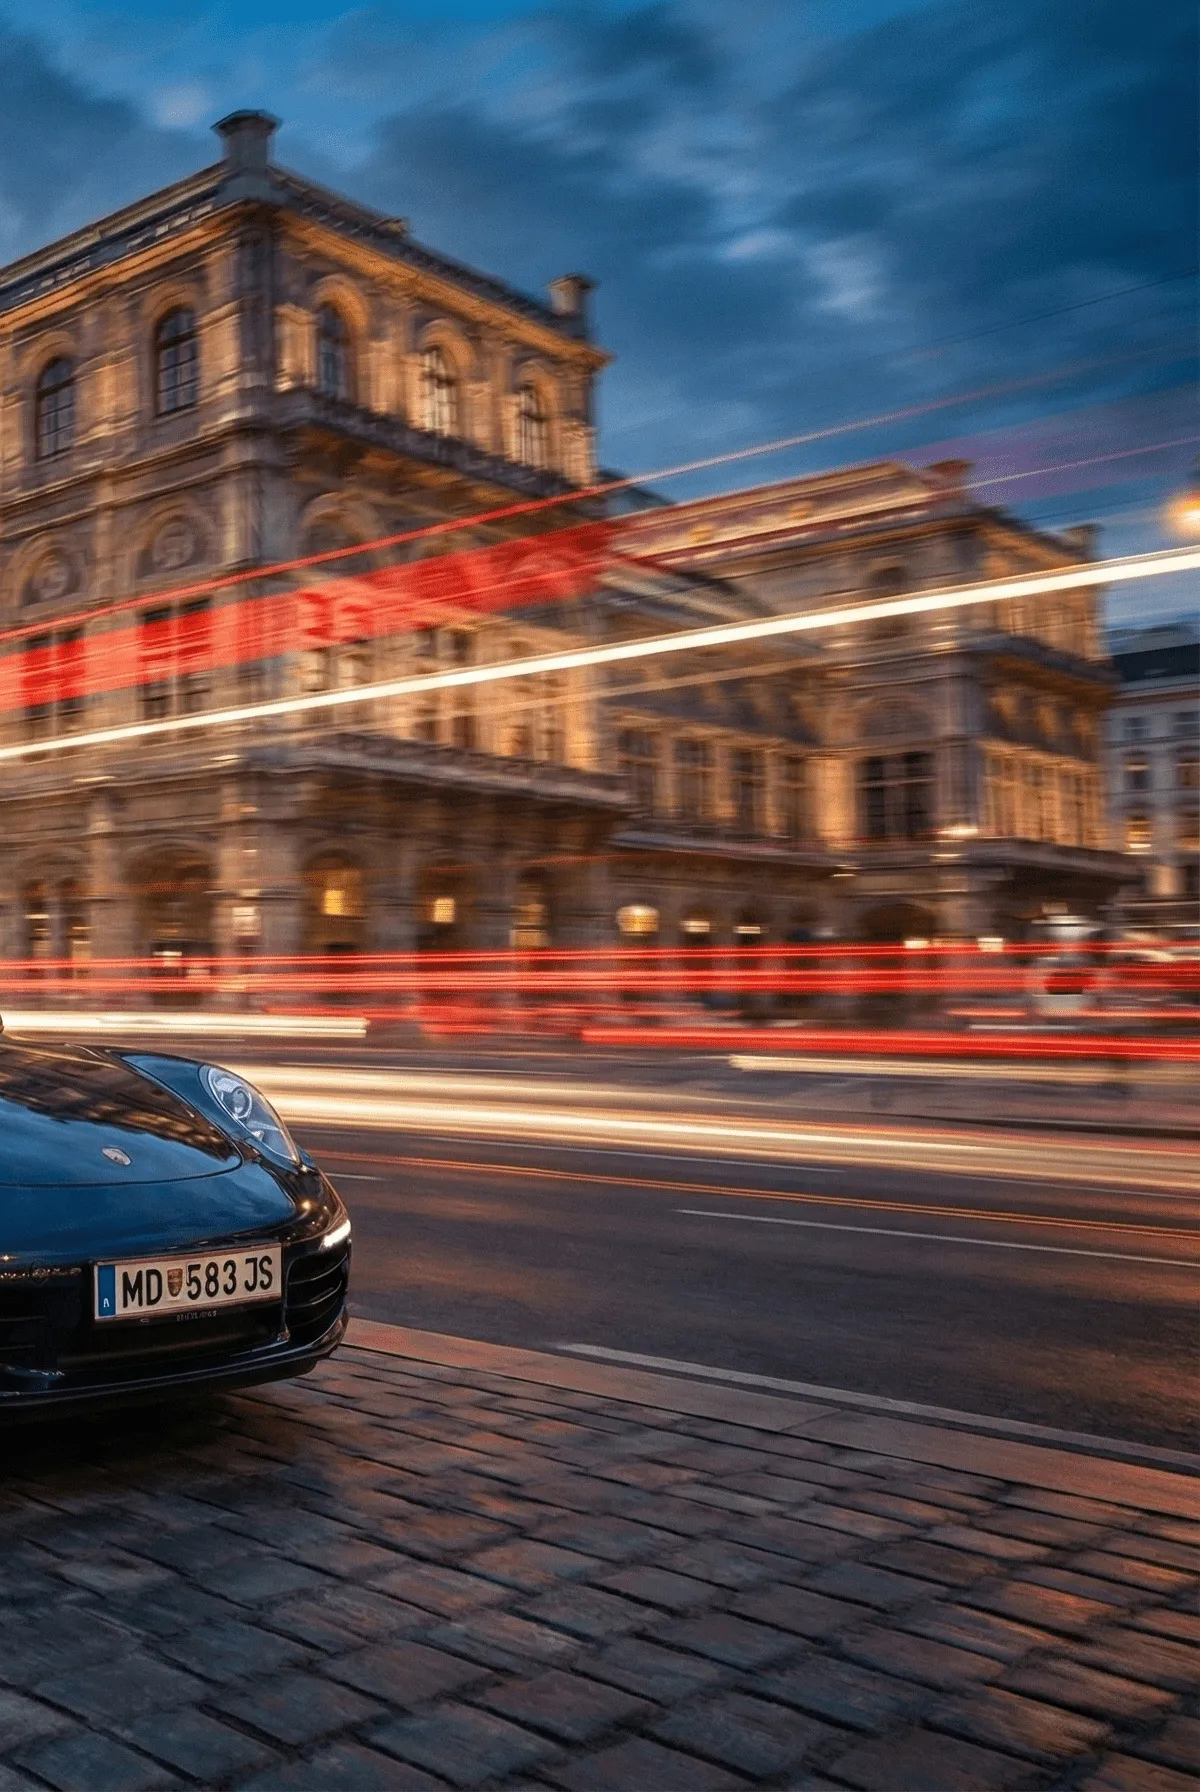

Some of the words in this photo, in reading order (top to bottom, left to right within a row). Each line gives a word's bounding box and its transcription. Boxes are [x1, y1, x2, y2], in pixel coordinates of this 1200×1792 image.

[122, 1269, 162, 1308] MD
[186, 1260, 237, 1300] 583
[244, 1255, 273, 1292] JS
